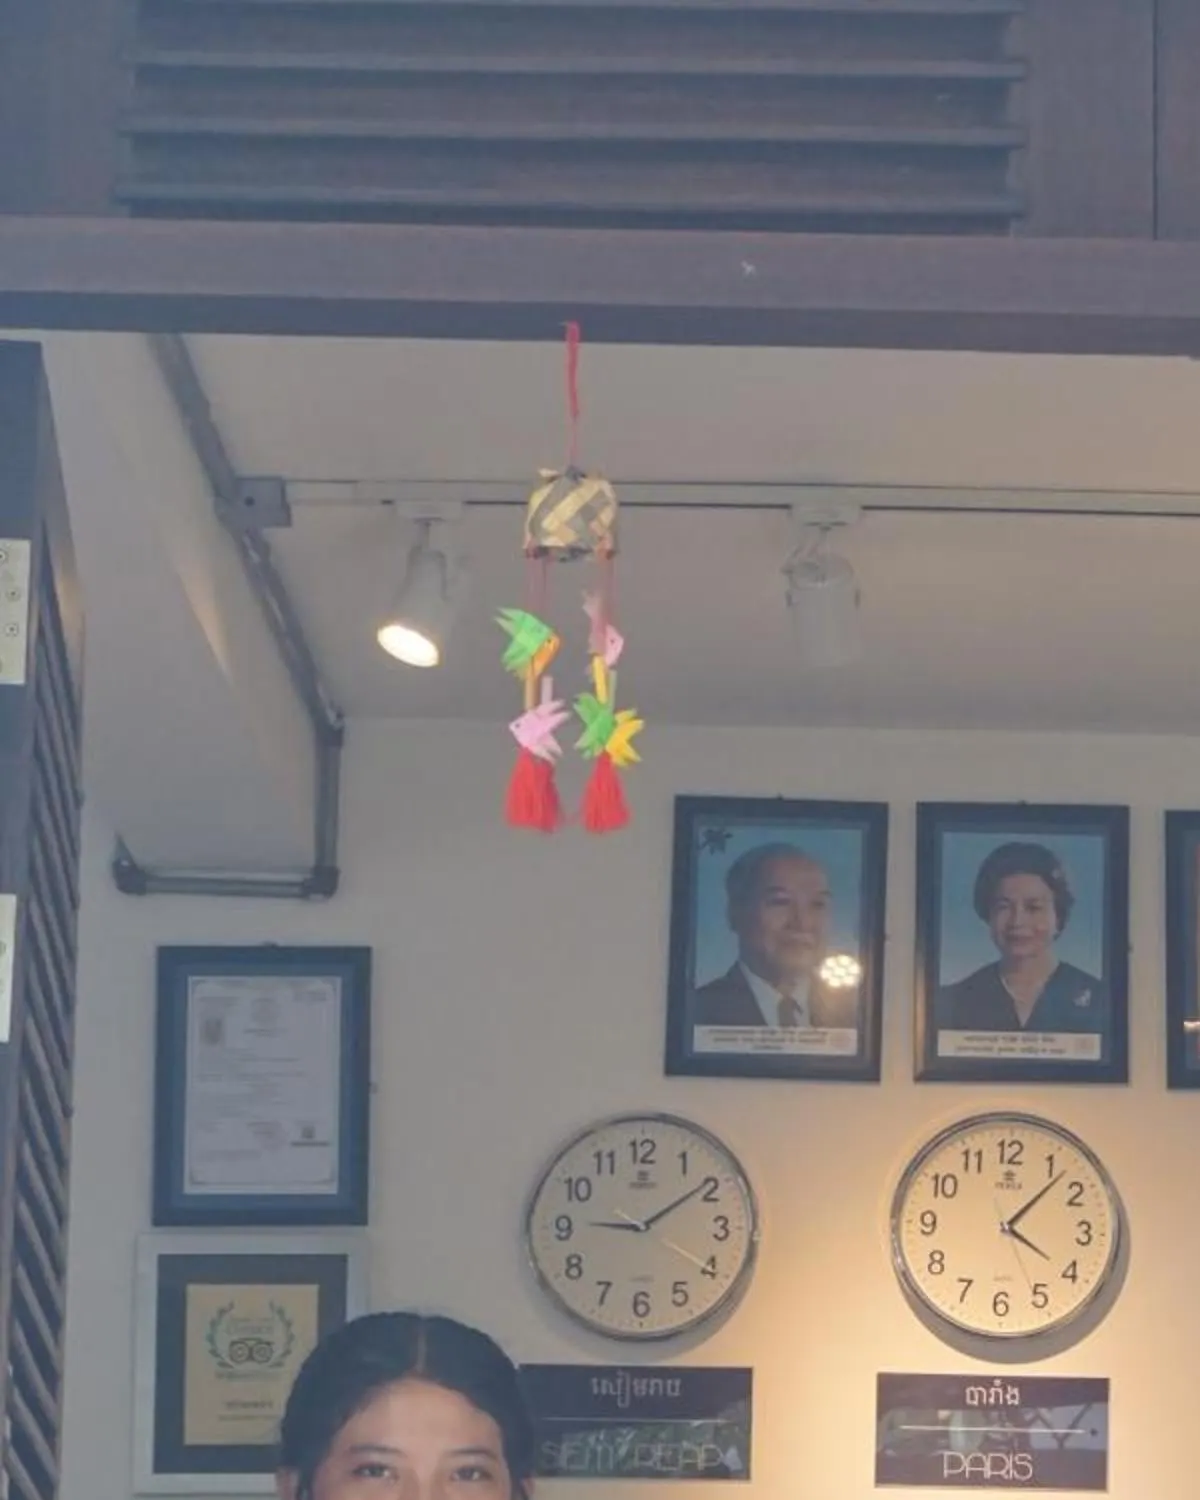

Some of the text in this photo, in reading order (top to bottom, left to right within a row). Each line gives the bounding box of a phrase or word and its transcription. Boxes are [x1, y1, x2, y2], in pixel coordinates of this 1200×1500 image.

[593, 1151, 615, 1175] 11
[629, 1138, 656, 1165] 12
[678, 1151, 688, 1175] 1
[962, 1149, 983, 1174] 11
[997, 1139, 1025, 1165] 12
[1045, 1155, 1055, 1179] 1
[564, 1177, 592, 1202] 10
[702, 1177, 720, 1202] 2
[931, 1173, 958, 1199] 10
[1067, 1182, 1085, 1207] 2
[555, 1215, 573, 1241] 9
[713, 1215, 730, 1241] 3
[920, 1210, 937, 1236] 9
[1075, 1221, 1093, 1246] 3
[565, 1254, 583, 1280] 8
[700, 1256, 717, 1279] 4
[927, 1250, 945, 1275] 8
[1061, 1260, 1078, 1284] 4
[597, 1281, 612, 1306] 7
[672, 1281, 689, 1307] 5
[957, 1278, 973, 1304] 7
[1031, 1284, 1049, 1309] 5
[633, 1291, 651, 1318] 6
[993, 1292, 1010, 1317] 6
[943, 1451, 1033, 1481] PARIS
